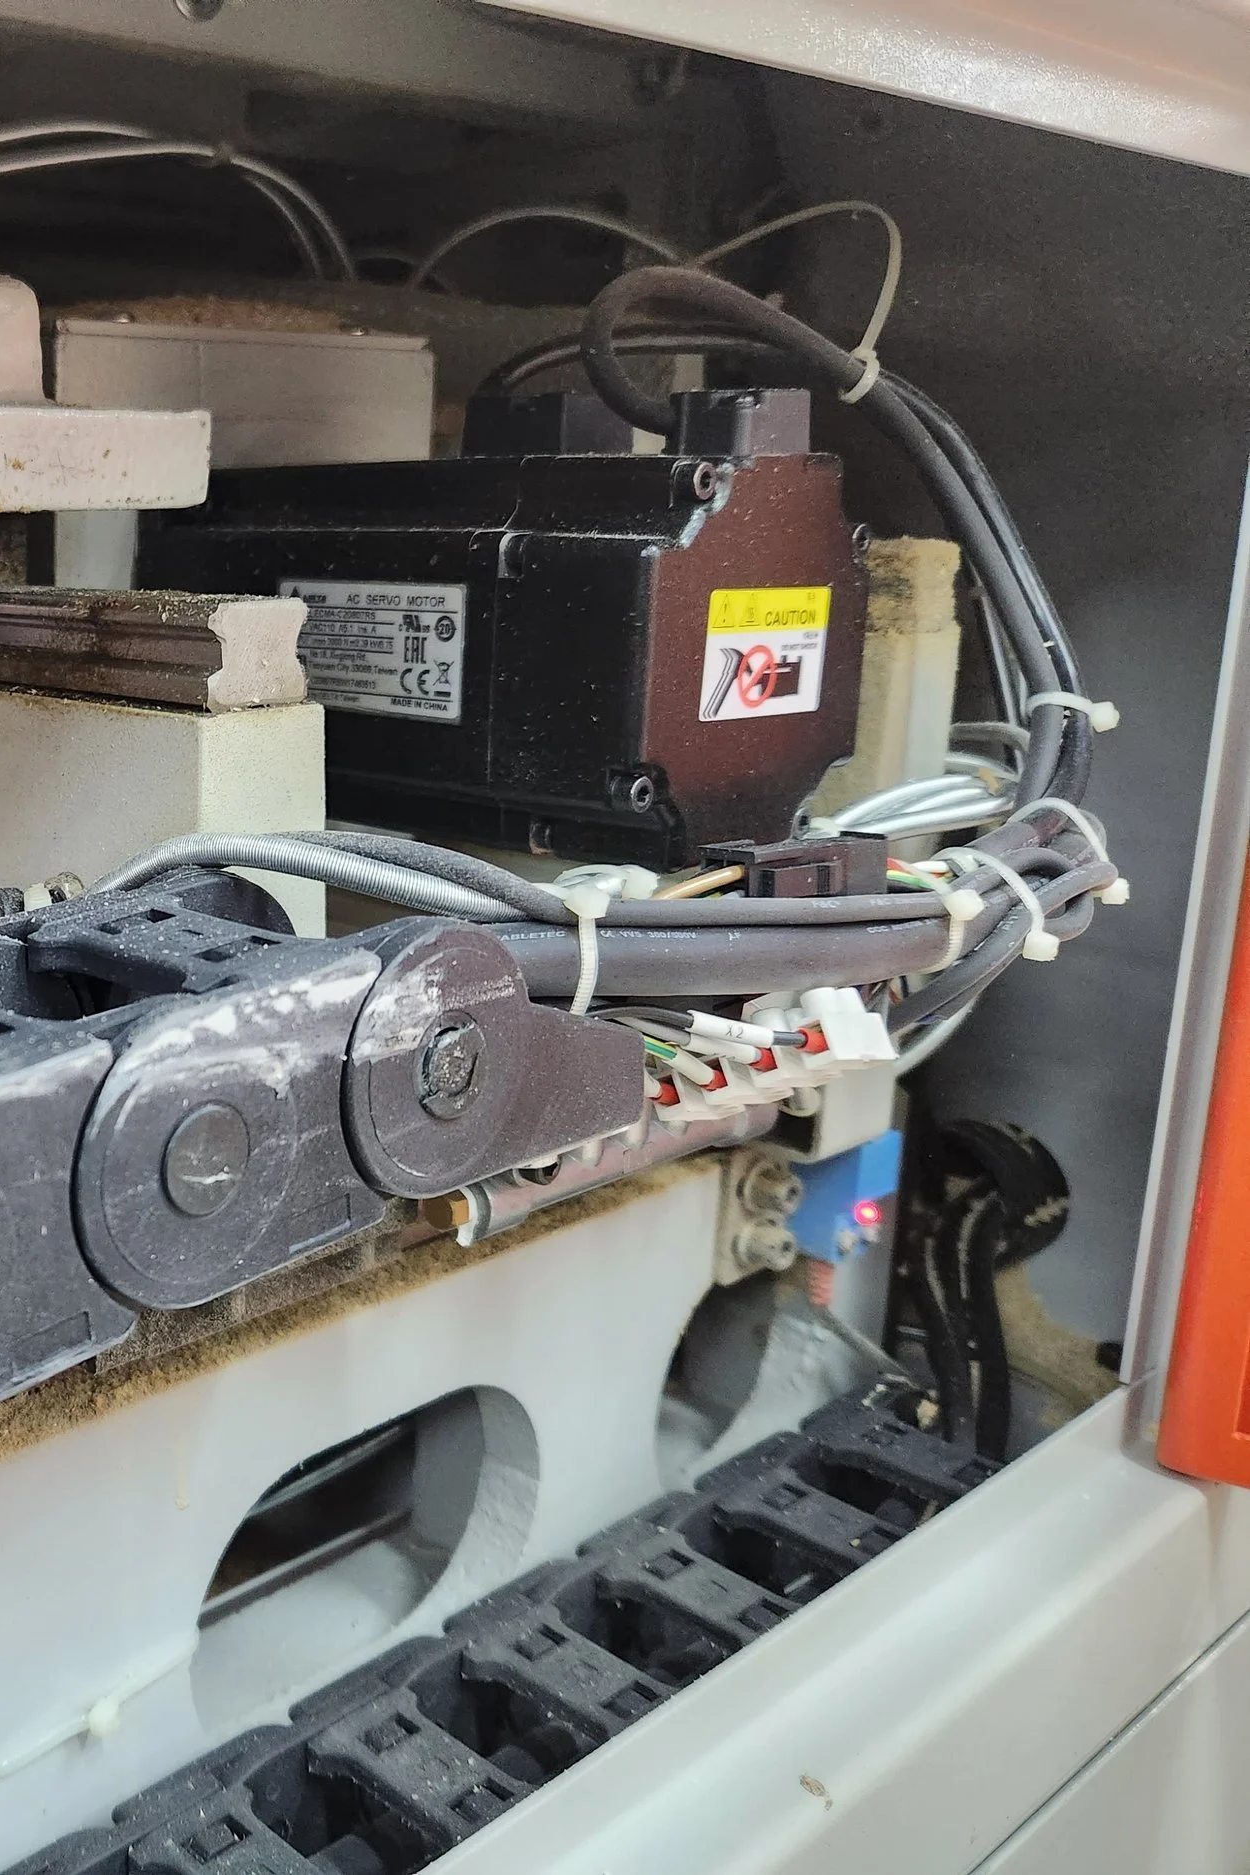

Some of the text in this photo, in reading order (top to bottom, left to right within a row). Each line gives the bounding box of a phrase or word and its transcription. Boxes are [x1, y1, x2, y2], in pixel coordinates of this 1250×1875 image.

[346, 594, 445, 607] AC SERVO MOTOR
[765, 610, 816, 626] CAUTION
[390, 698, 448, 711] MADE IN CHINA
